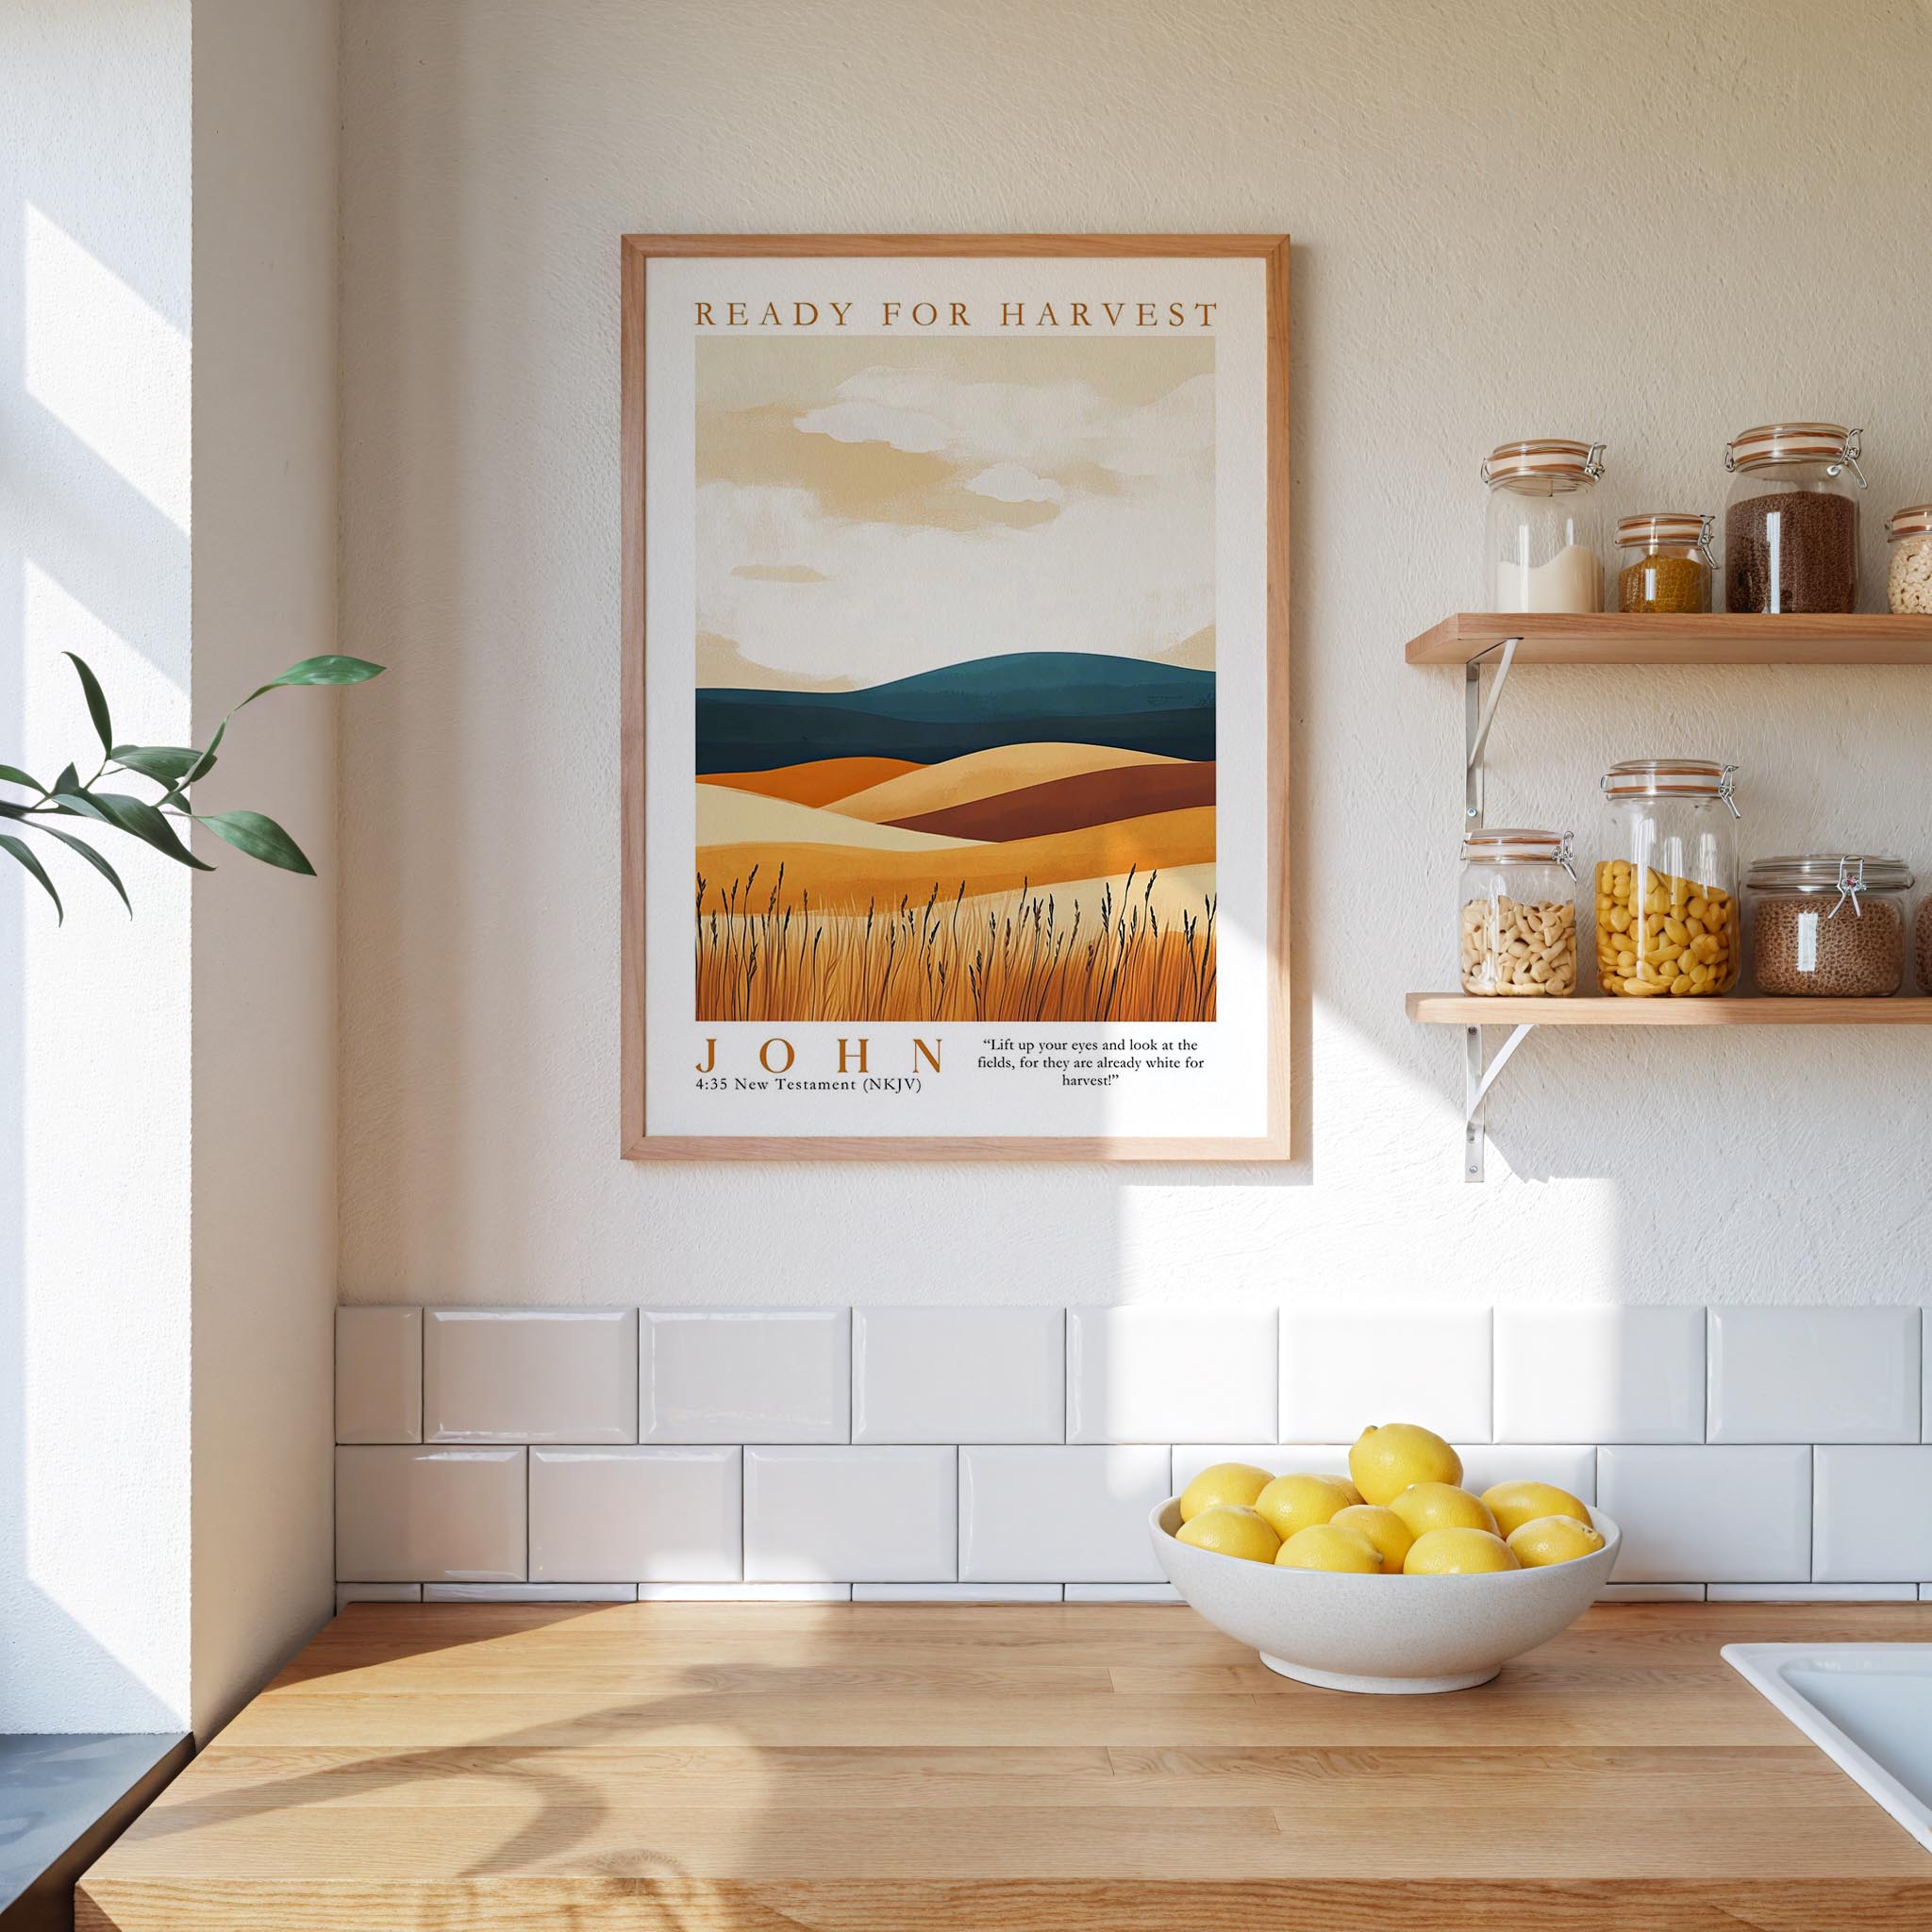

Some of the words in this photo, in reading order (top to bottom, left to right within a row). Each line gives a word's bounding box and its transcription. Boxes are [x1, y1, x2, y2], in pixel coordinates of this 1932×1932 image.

[694, 302, 854, 326] READY
[883, 302, 972, 326] FOR
[1000, 302, 1218, 327] HARVEST
[983, 1039, 1014, 1051] “Lift
[1019, 1041, 1035, 1054] up
[1039, 1041, 1068, 1054] your
[1072, 1041, 1098, 1054] eyes
[1102, 1039, 1124, 1051] and
[1129, 1039, 1158, 1051] look
[1162, 1041, 1174, 1051] at
[1178, 1039, 1198, 1051] the
[695, 1038, 942, 1074] JOHN
[977, 1057, 1015, 1070] fields,
[1020, 1057, 1039, 1068] for
[1042, 1057, 1070, 1072] they
[1074, 1059, 1093, 1068] are
[1097, 1057, 1141, 1072] already
[1145, 1057, 1181, 1068] white
[1185, 1057, 1205, 1068] for
[695, 1077, 727, 1091] 4:35
[735, 1077, 769, 1091] New
[774, 1077, 857, 1091] Testament
[863, 1077, 922, 1094] (NKJV)
[1062, 1074, 1119, 1086] harvest!”
